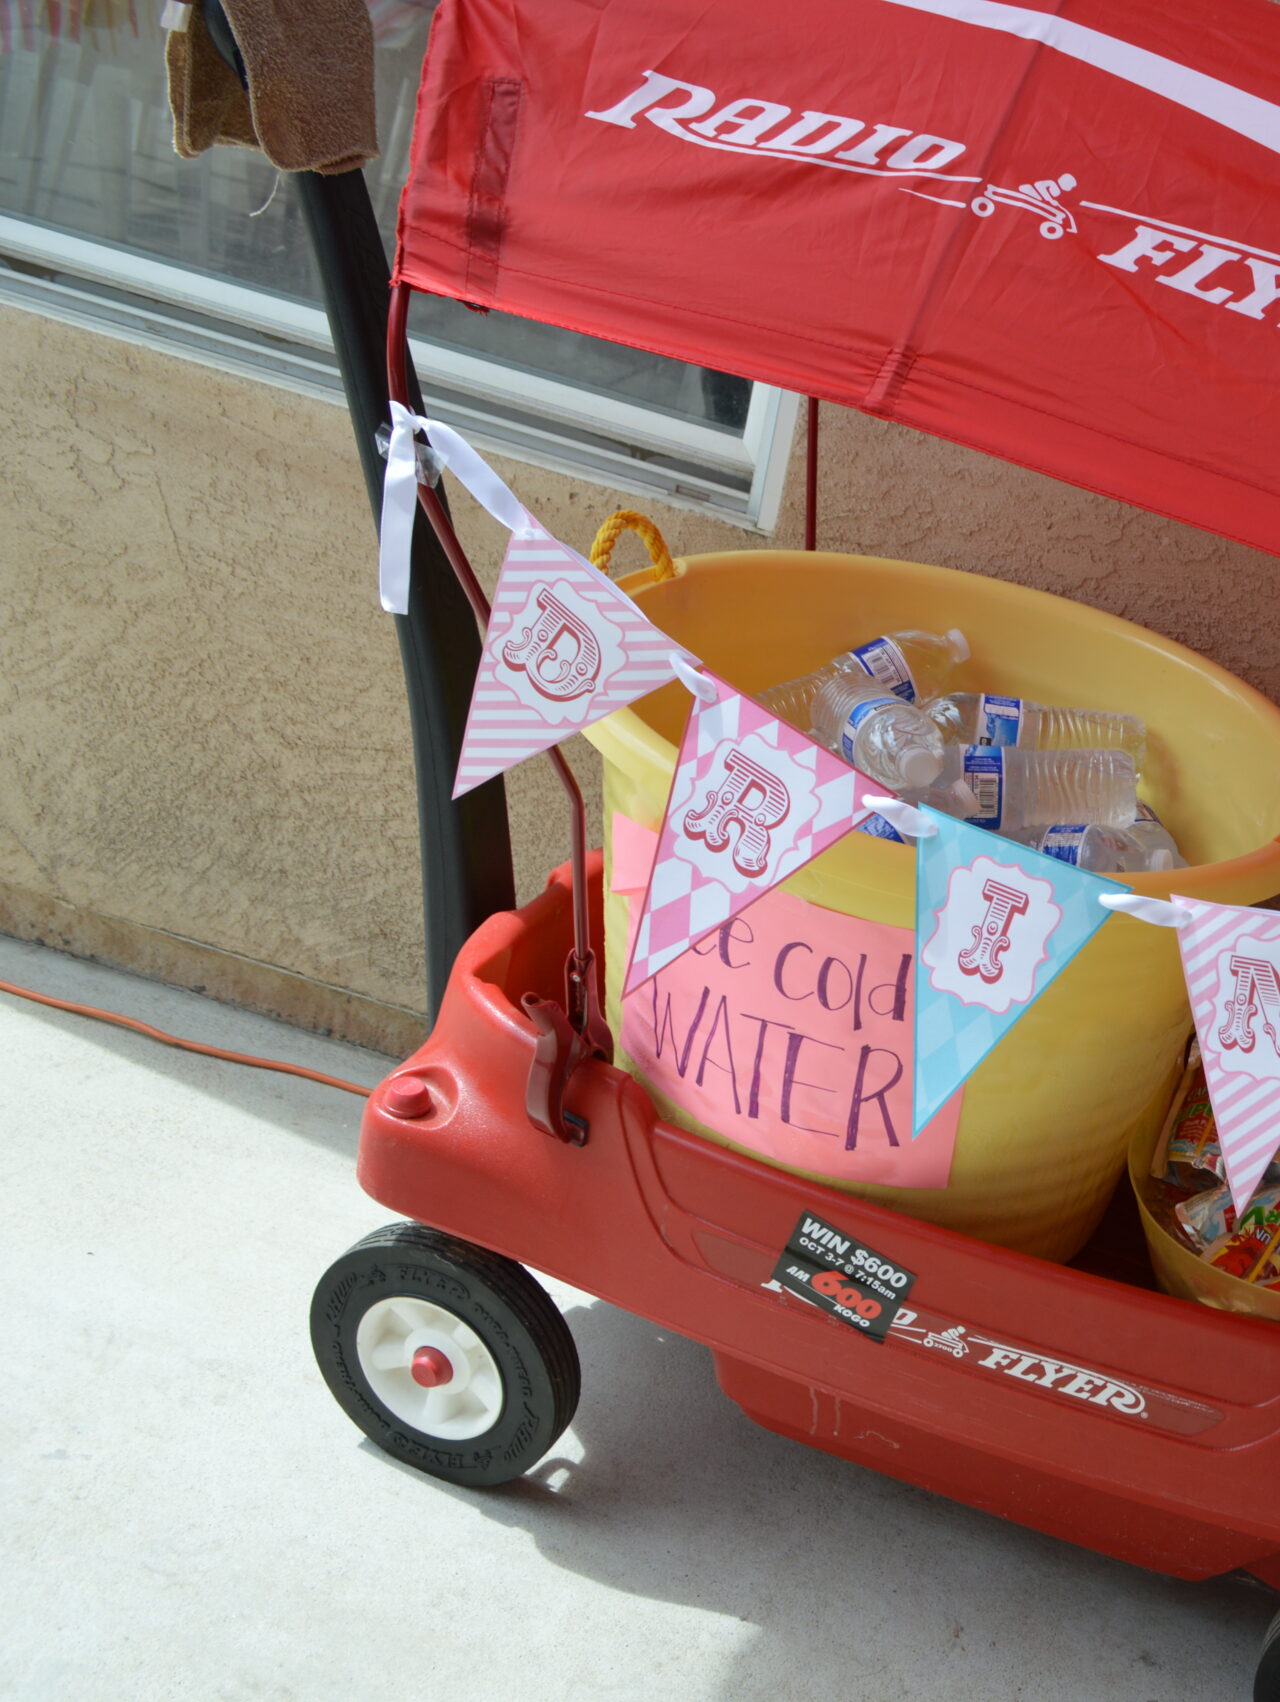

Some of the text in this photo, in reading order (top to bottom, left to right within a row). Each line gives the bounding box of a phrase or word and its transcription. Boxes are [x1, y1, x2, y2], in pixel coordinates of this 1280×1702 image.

[584, 69, 970, 173] RADIO
[653, 976, 904, 1151] WATER
[798, 1236, 826, 1255] OCT
[824, 1252, 846, 1267] 3-7
[855, 1270, 897, 1301] 7:15am
[801, 1217, 908, 1289] WIN $600
[786, 1265, 811, 1283] AM
[810, 1270, 883, 1320] 600
[833, 1303, 871, 1328] KOGO
[977, 1347, 1146, 1415] FLYER
